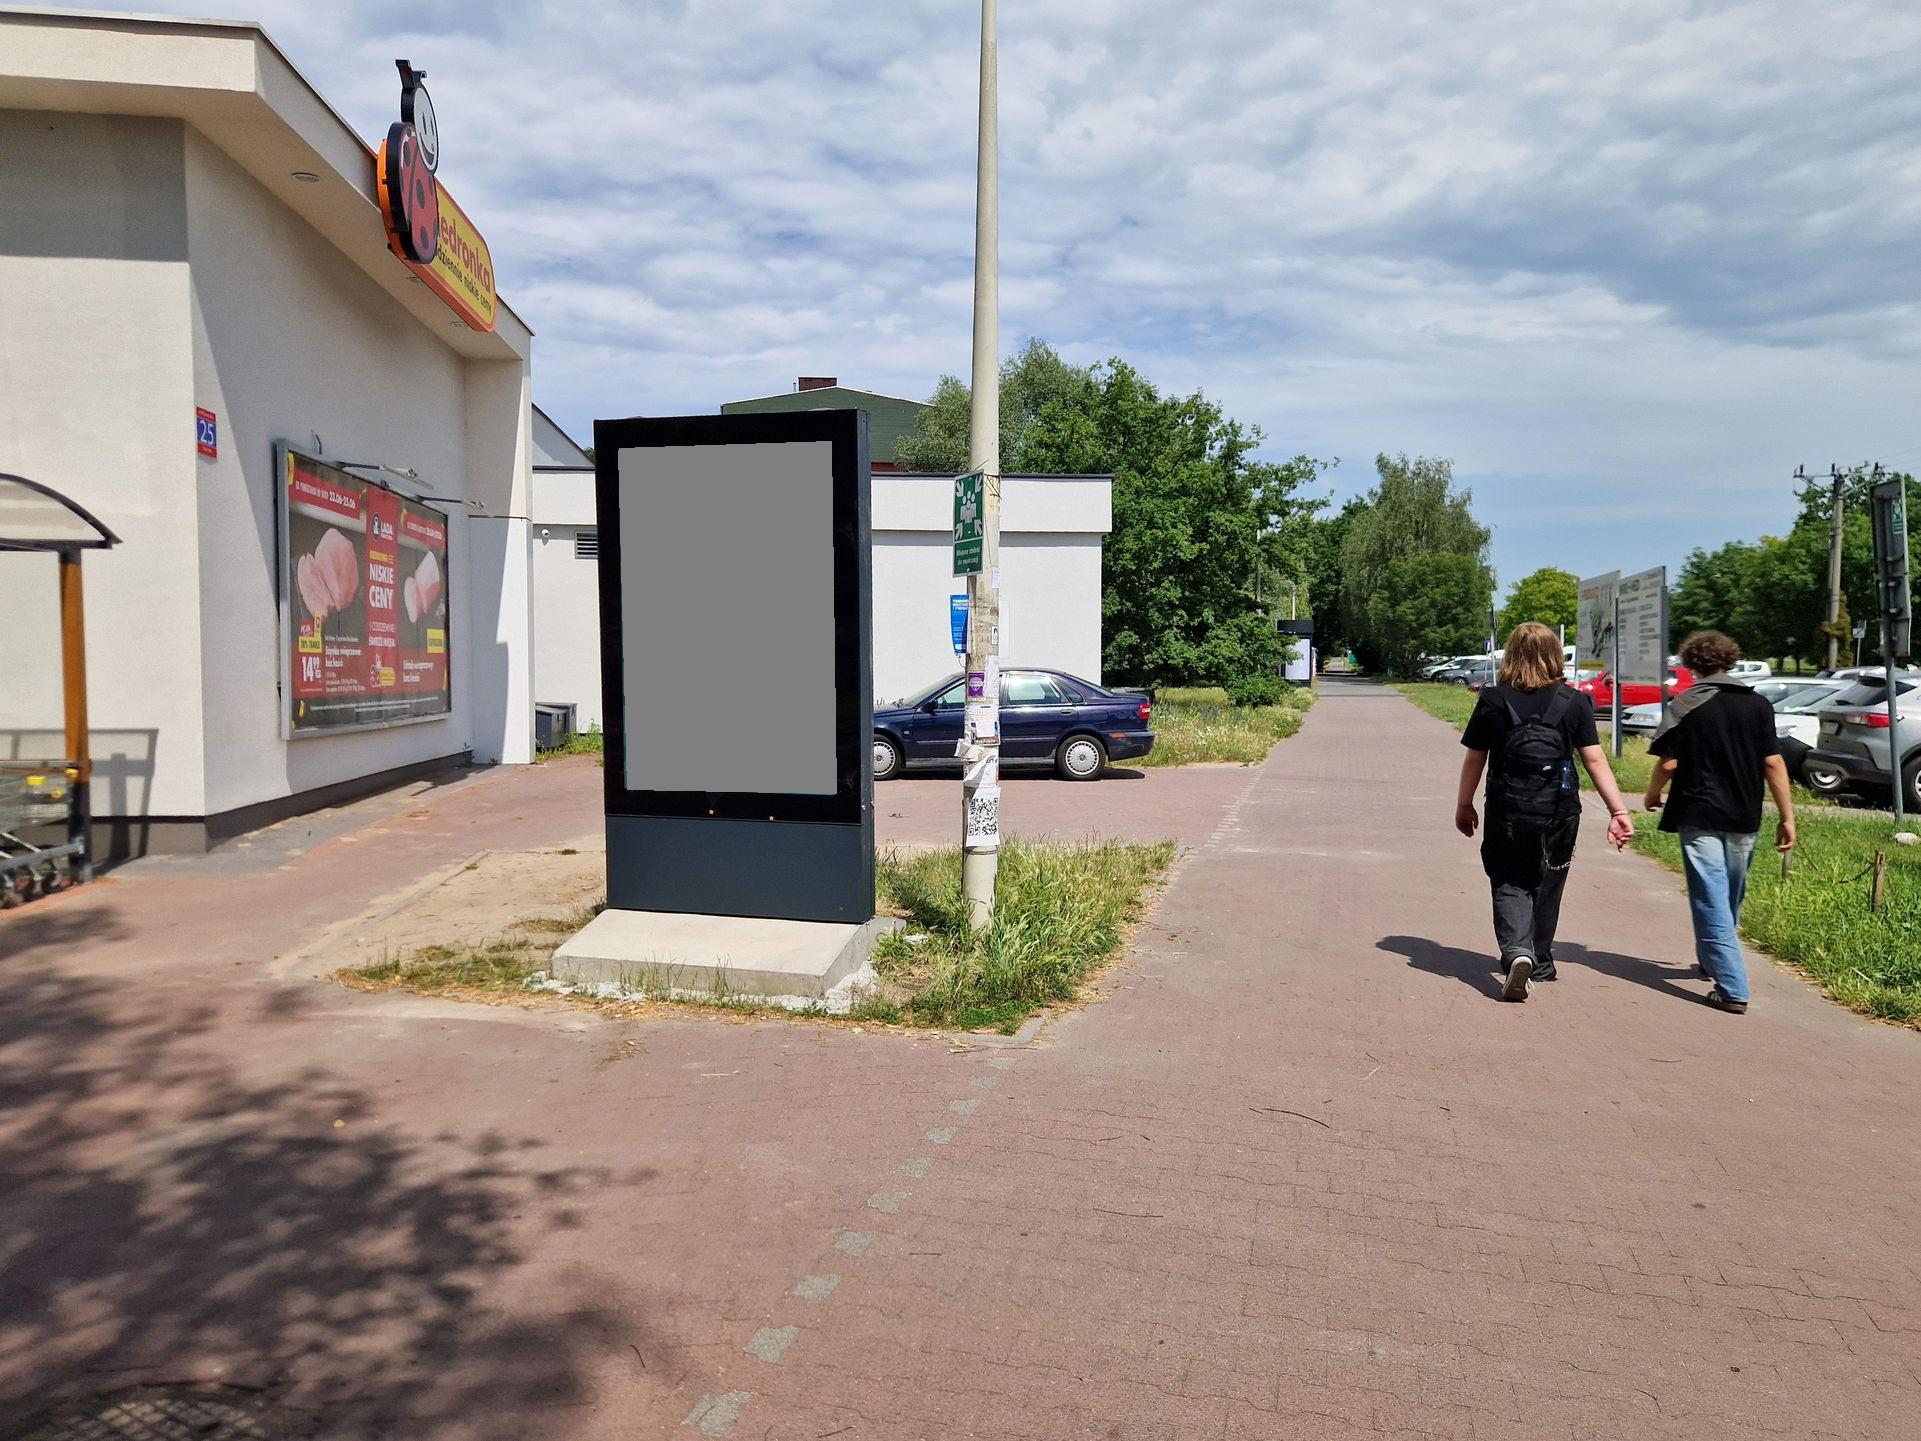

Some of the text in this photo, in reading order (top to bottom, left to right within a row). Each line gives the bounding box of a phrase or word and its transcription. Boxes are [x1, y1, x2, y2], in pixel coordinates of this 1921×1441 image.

[440, 216, 490, 294] edronka
[200, 419, 214, 446] 25
[369, 563, 394, 584] NISKIE
[369, 585, 394, 609] CENY
[302, 656, 314, 682] 14
